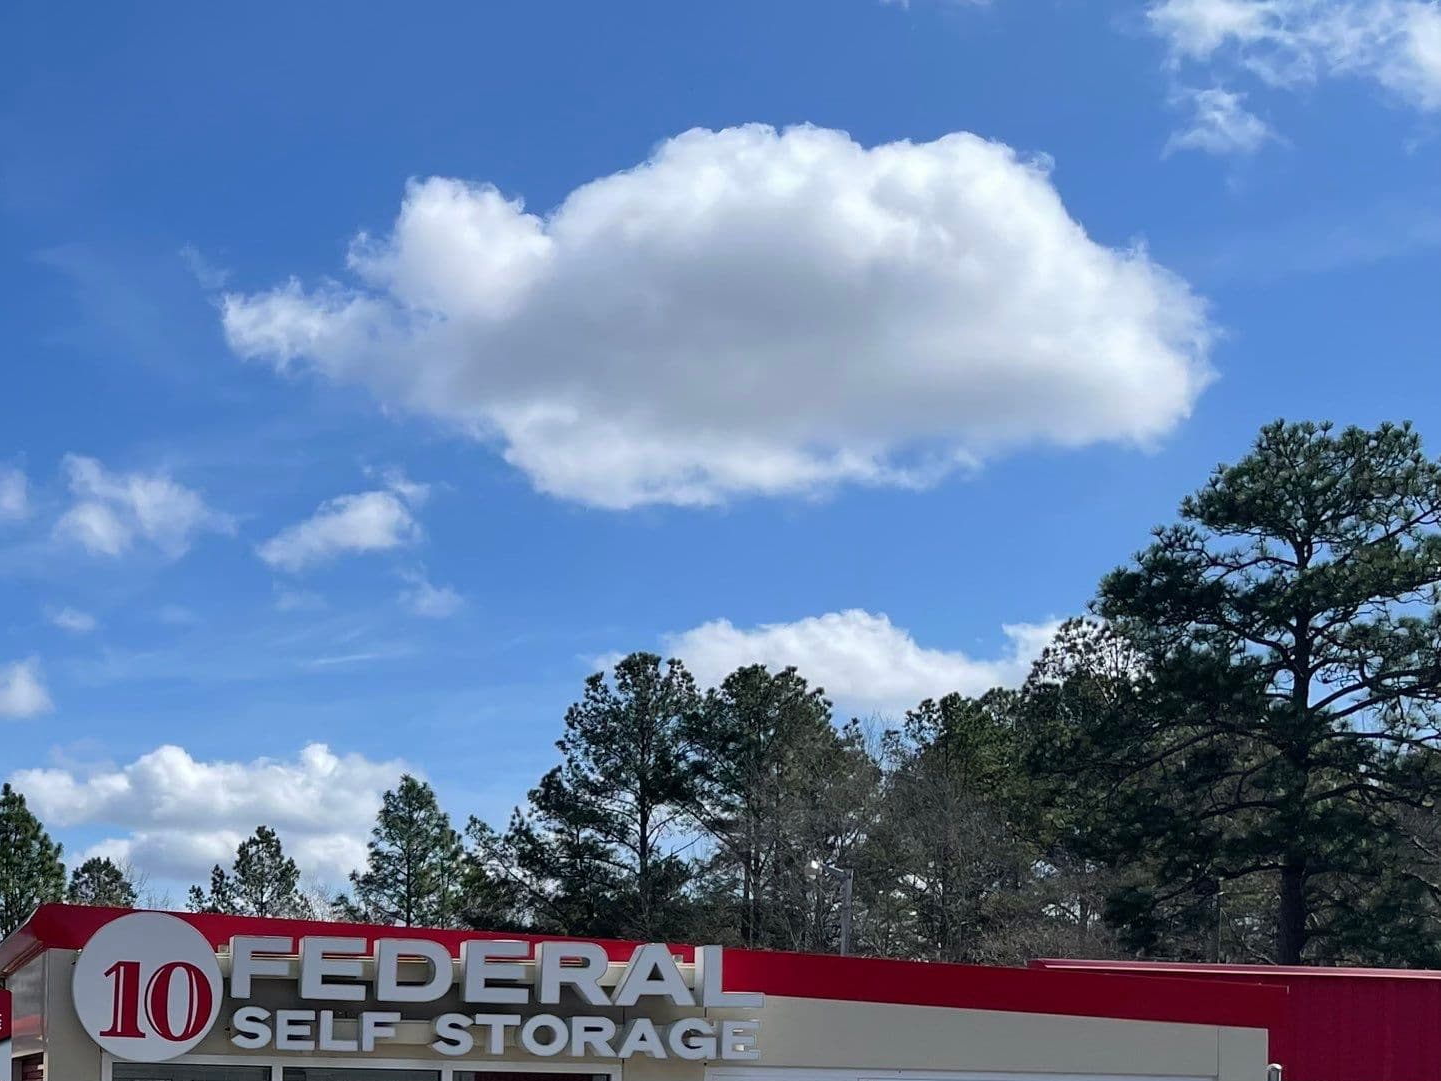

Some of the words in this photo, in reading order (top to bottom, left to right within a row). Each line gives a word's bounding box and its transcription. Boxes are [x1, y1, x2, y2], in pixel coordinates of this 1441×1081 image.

[99, 960, 215, 1042] 10
[229, 935, 765, 1008] FEDERAL
[230, 1006, 401, 1053] SELF
[430, 1011, 760, 1060] STORAGE
